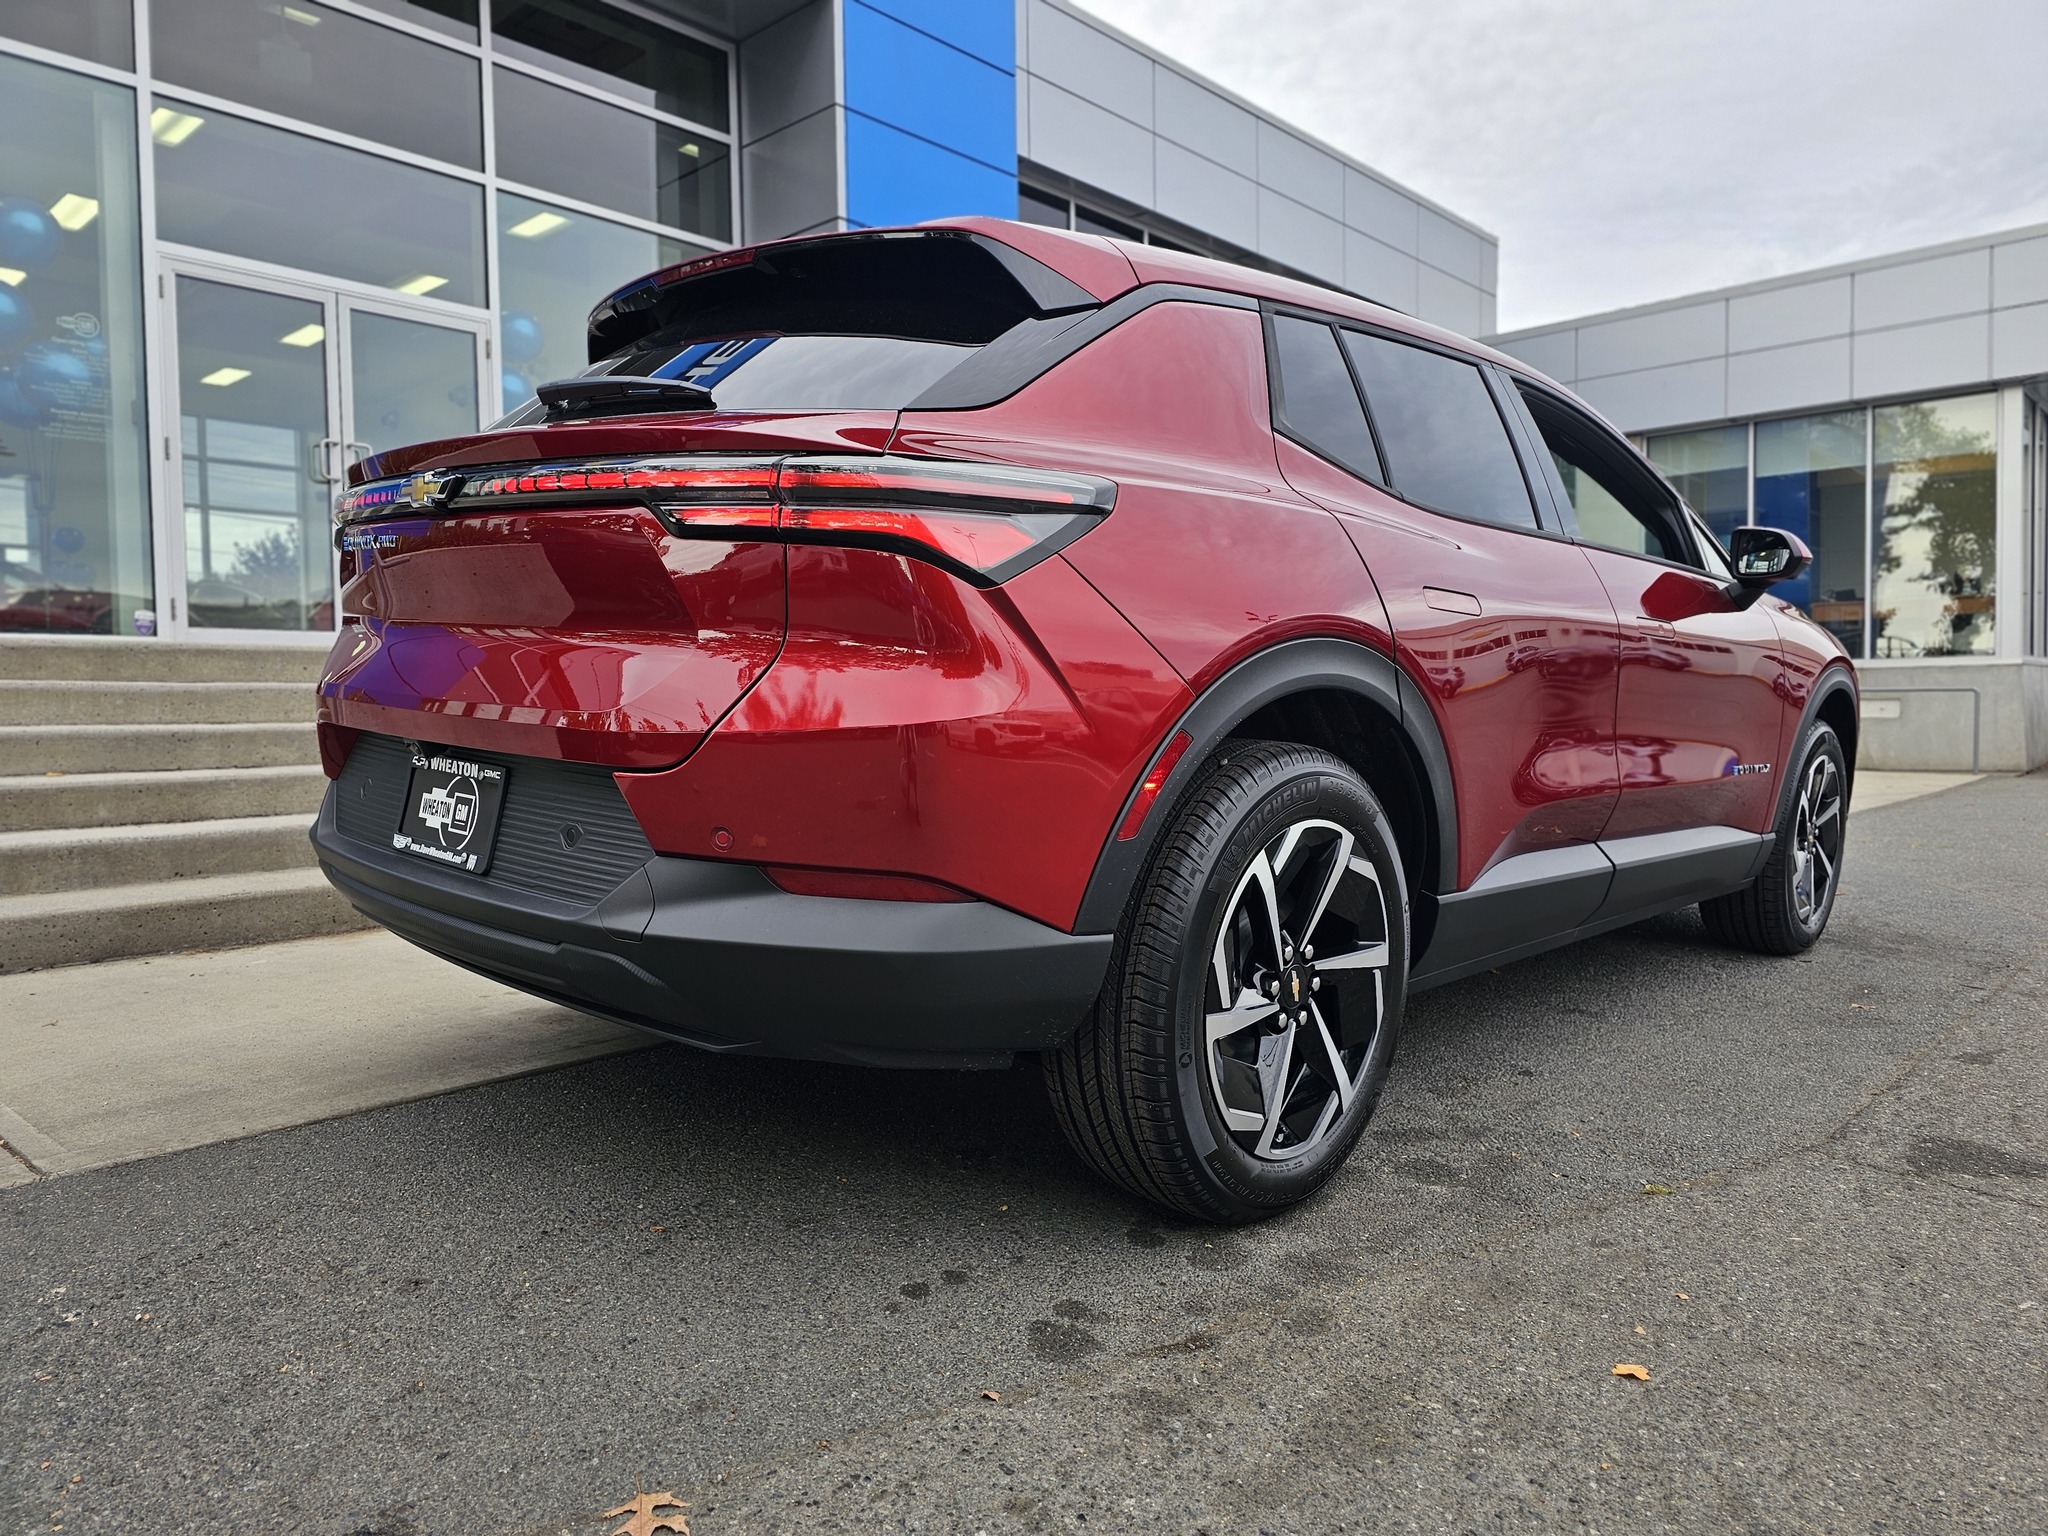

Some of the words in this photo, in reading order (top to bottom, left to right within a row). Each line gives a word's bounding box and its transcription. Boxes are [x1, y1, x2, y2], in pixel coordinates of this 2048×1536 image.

[430, 757, 479, 778] WHEATON
[484, 769, 501, 779] GMC
[422, 798, 452, 819] WHEATON
[455, 804, 469, 821] GM
[1243, 781, 1317, 846] MICHELIN
